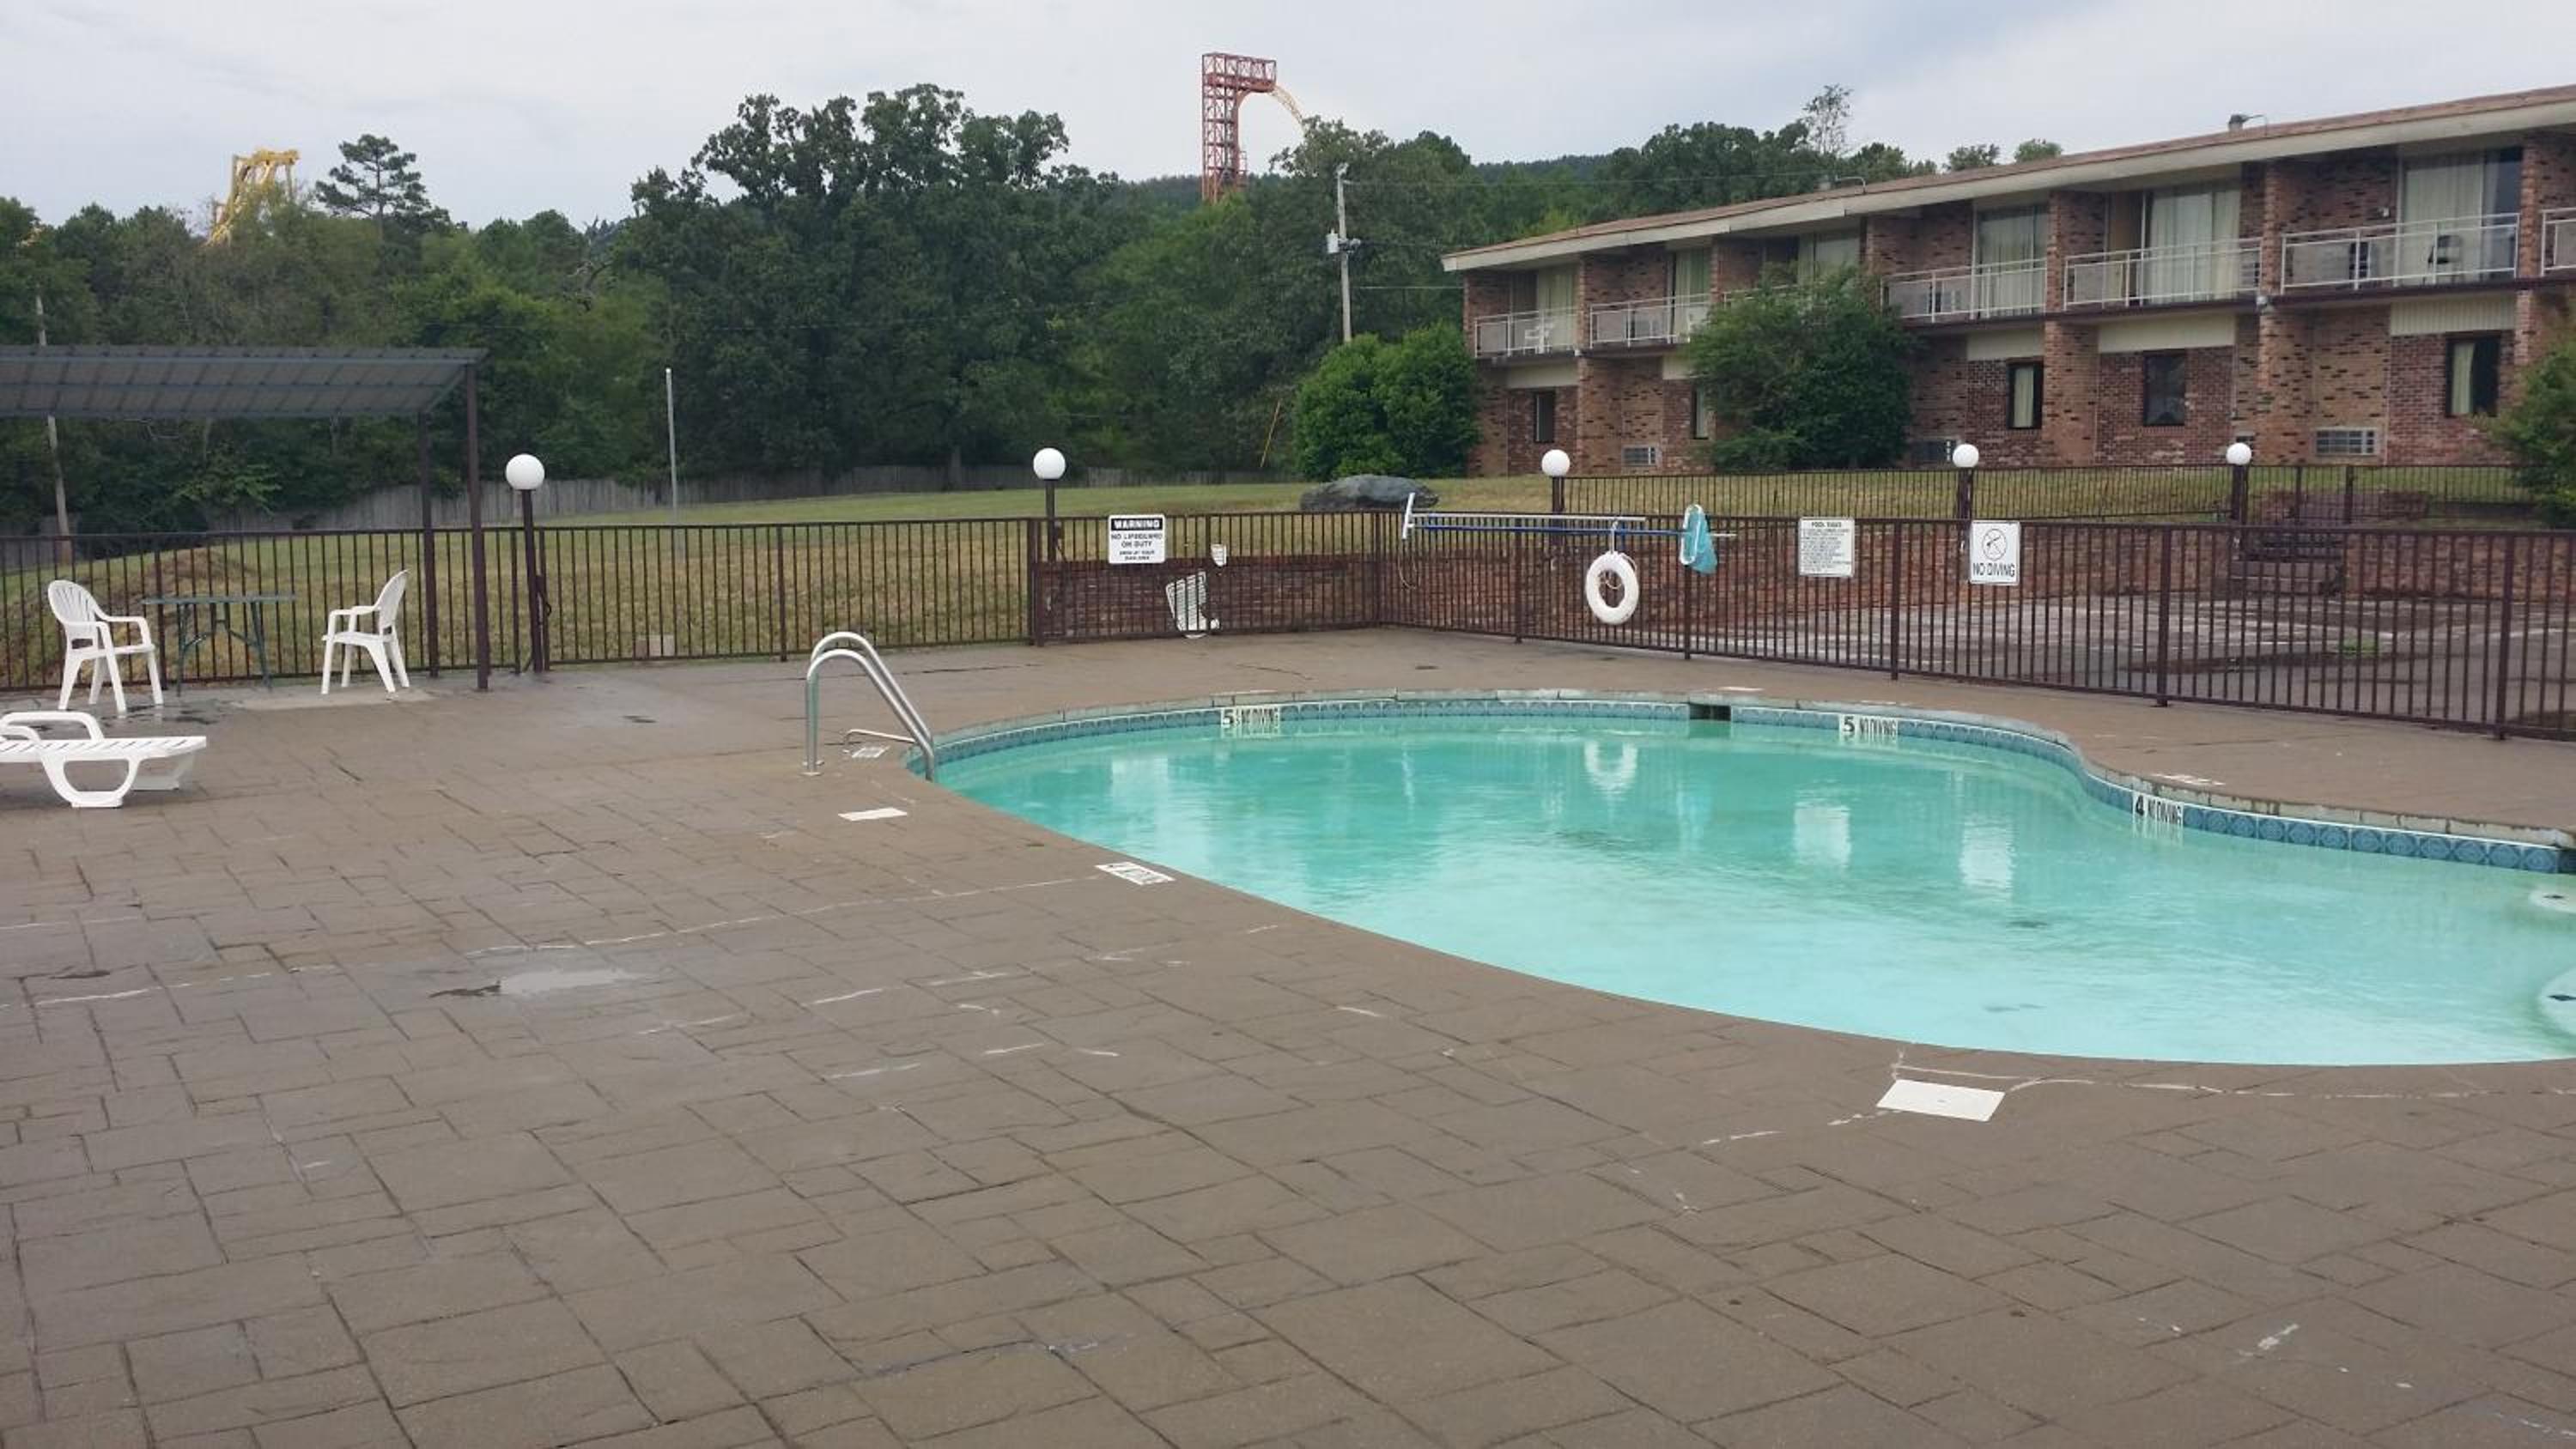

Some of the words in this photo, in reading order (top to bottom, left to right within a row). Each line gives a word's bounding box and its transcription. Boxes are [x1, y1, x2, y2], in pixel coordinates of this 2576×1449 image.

[1114, 519, 1160, 530] WARNING
[1972, 562, 1985, 576] NO
[1987, 562, 2015, 578] DIVING
[1843, 715, 1855, 733] 5
[2136, 795, 2145, 816] 4
